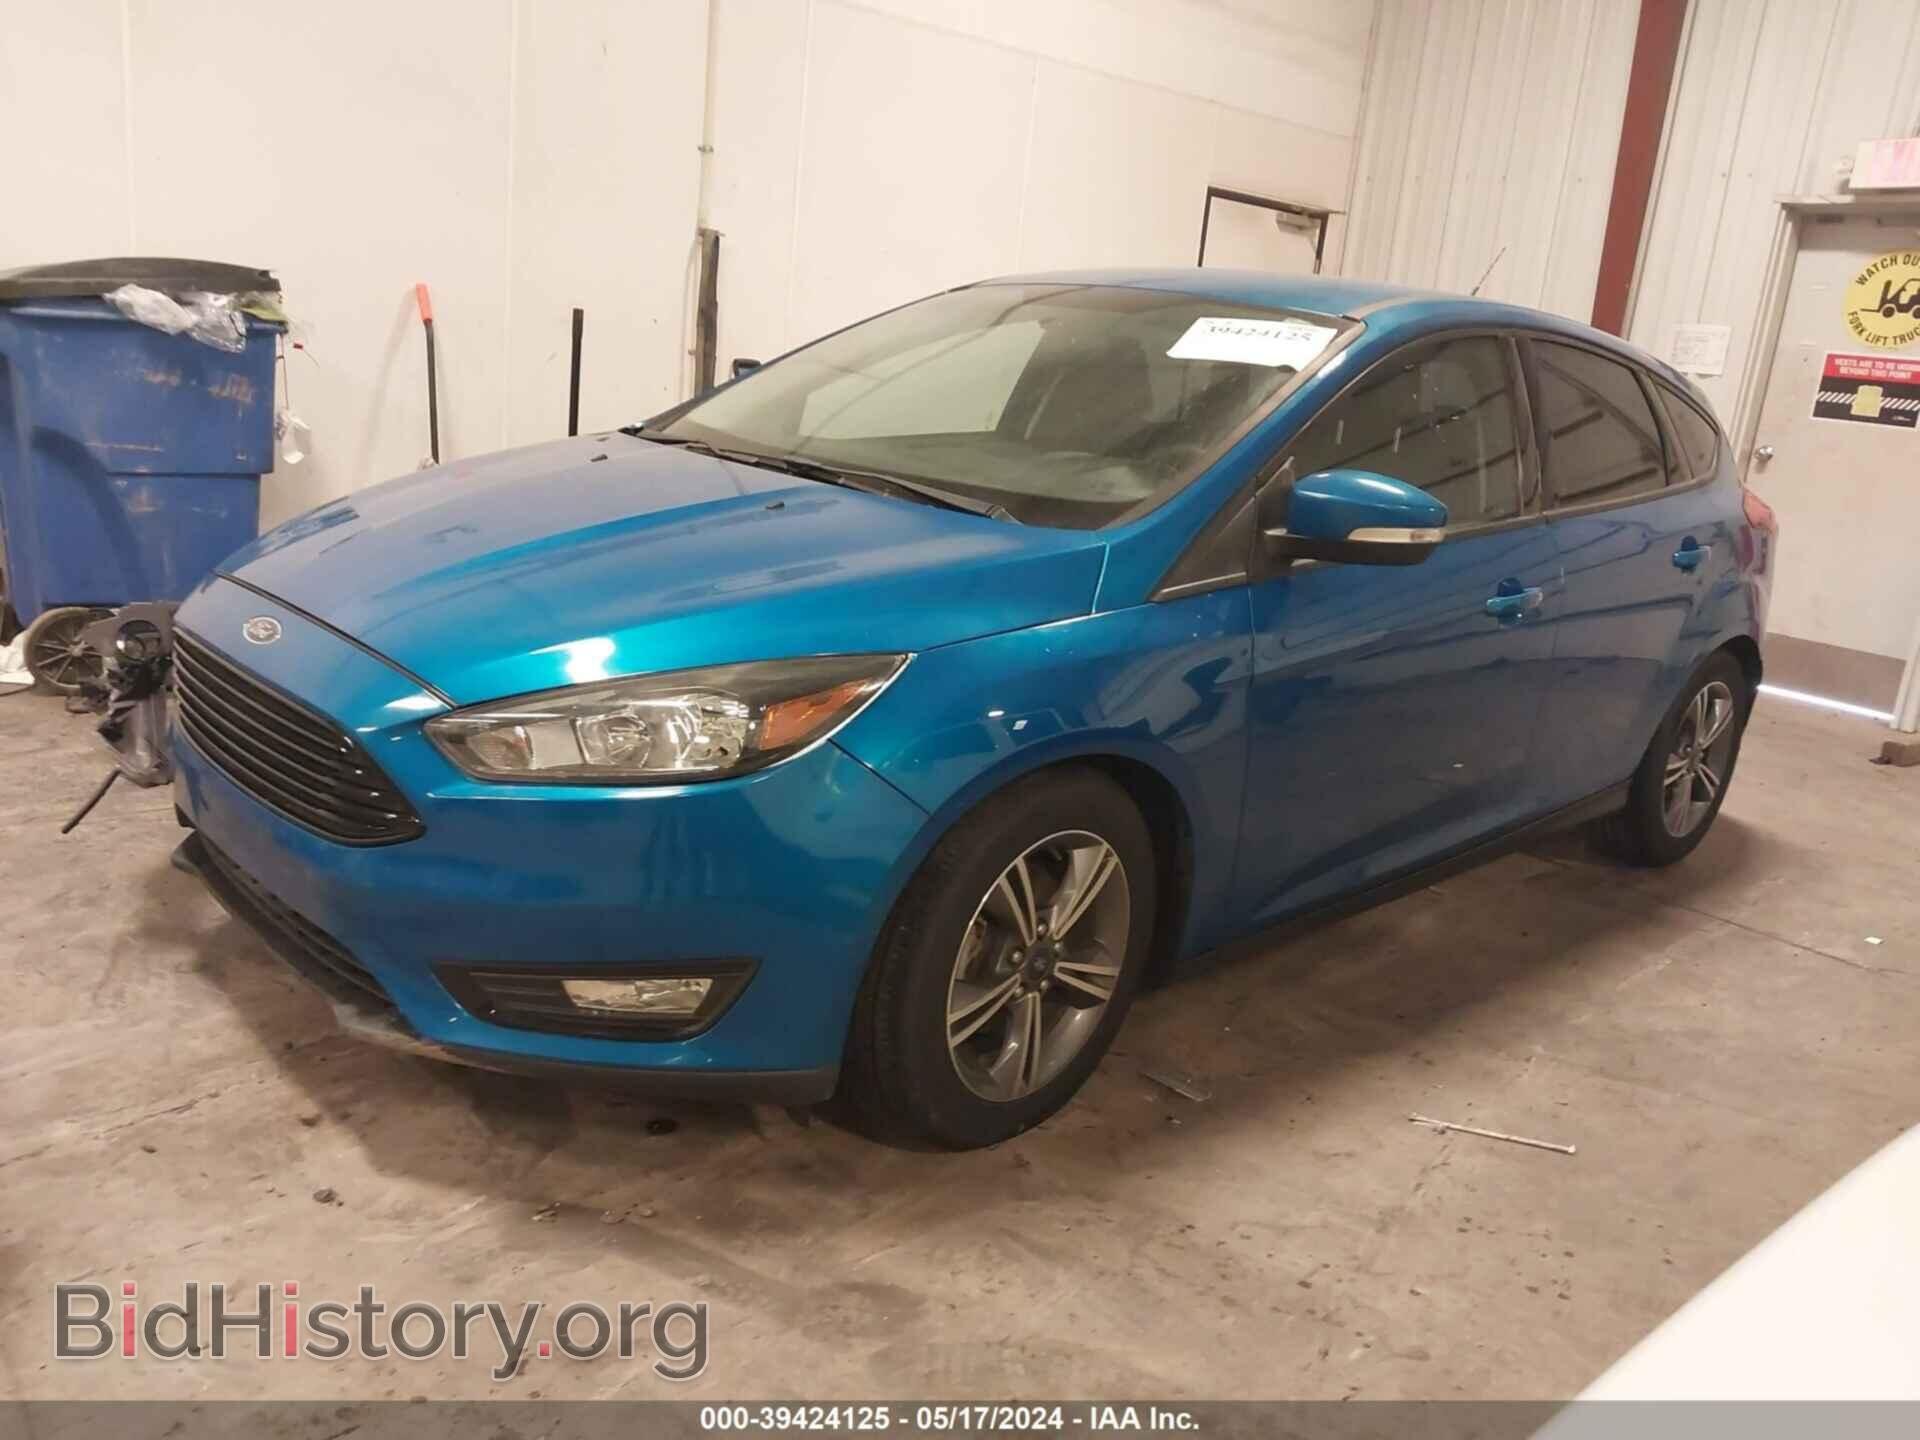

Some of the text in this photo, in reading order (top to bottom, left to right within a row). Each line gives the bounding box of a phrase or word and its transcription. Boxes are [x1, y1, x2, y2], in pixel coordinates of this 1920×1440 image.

[1856, 255, 1898, 285] WATCH
[1848, 311, 1867, 336] FORK
[1865, 332, 1888, 346] LIFT
